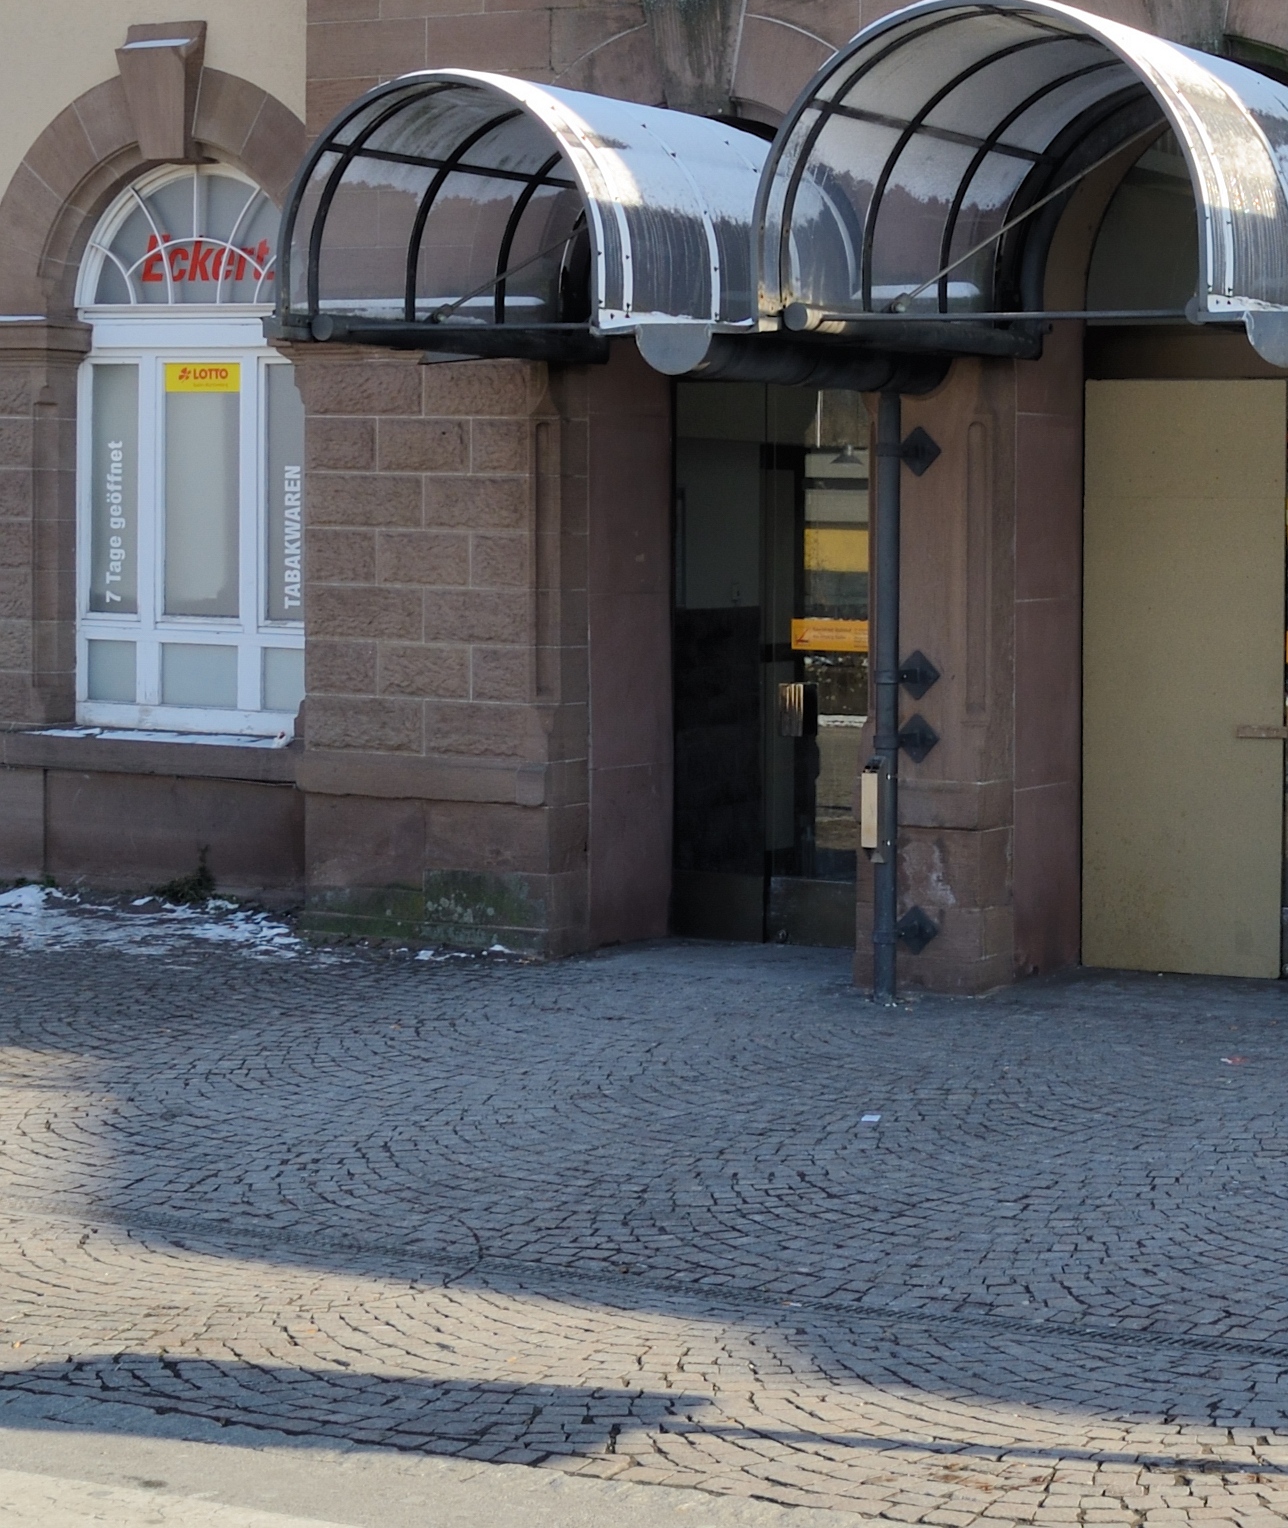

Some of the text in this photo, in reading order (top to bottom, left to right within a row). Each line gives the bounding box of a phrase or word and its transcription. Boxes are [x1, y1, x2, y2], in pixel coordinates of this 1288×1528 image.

[193, 368, 228, 380] LOTTO
[105, 440, 125, 603] 7 Tage geöffnet
[284, 465, 301, 610] TABAKWAREN
